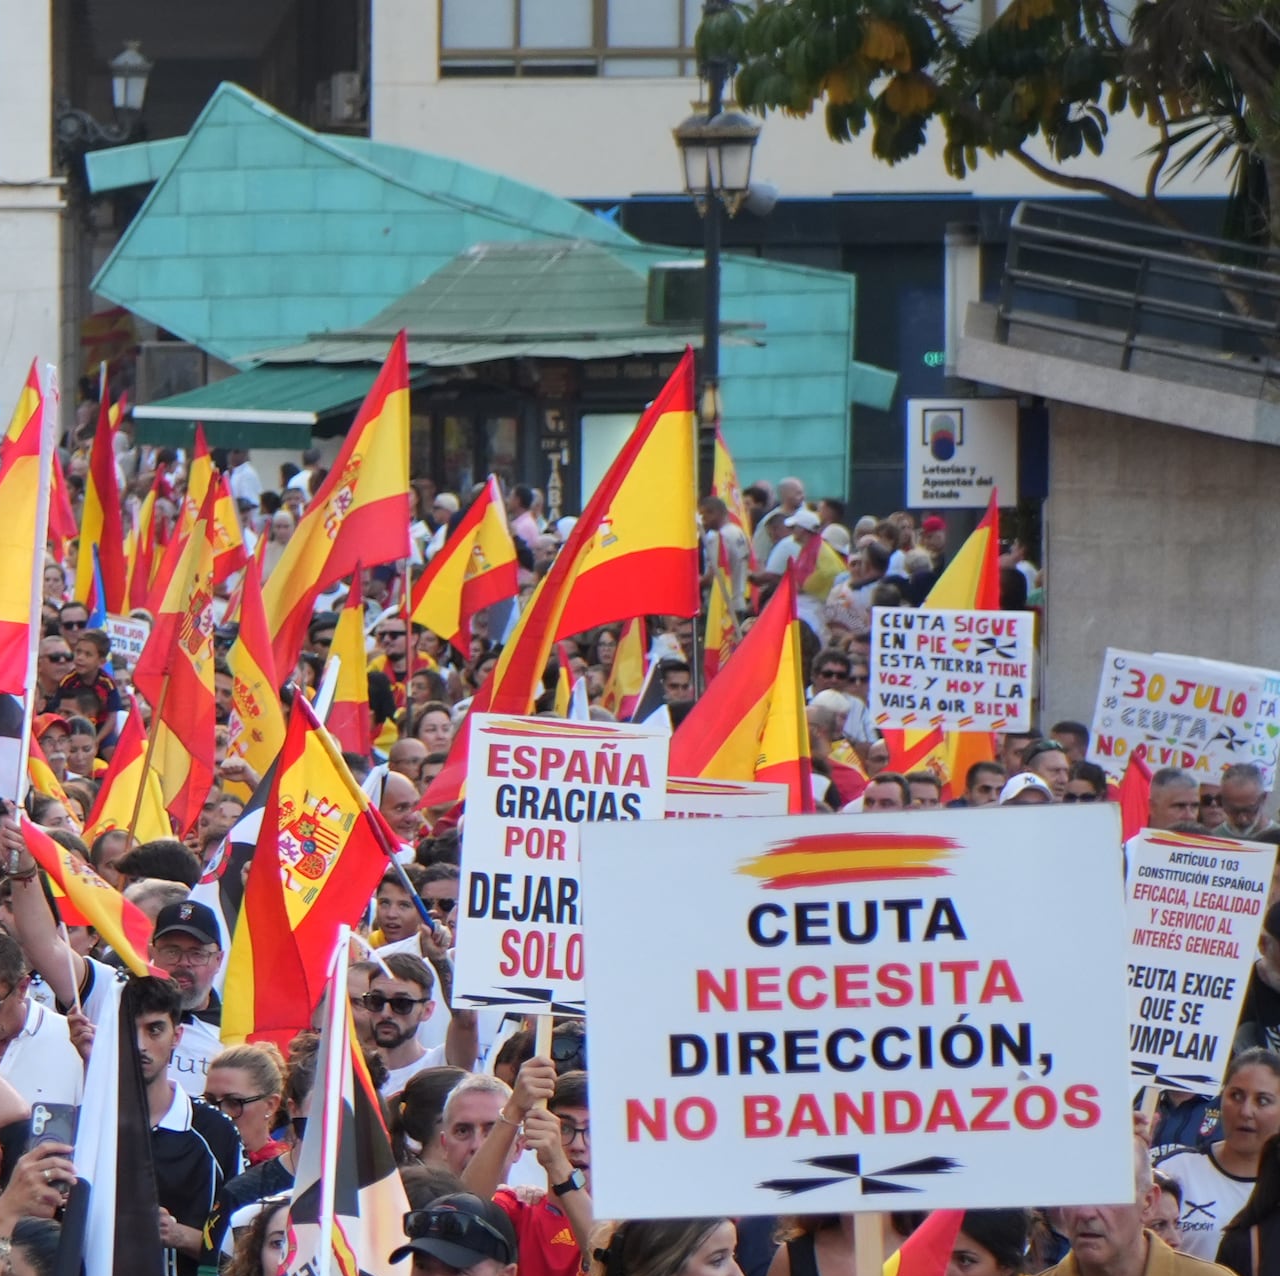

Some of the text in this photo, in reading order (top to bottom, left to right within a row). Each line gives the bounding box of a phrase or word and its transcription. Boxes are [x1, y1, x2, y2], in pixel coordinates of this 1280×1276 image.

[880, 613, 1017, 638] CEUTA SIGUE
[880, 633, 947, 654] EN PIE
[880, 654, 1027, 678] ESTA TIERRA TIENE
[879, 672, 1023, 698] VOZ, Y HOY LA
[1123, 668, 1166, 703] 30
[1169, 680, 1247, 718] JULIO
[880, 693, 1018, 717] VAIS A OIR BIEN
[1121, 707, 1207, 740] CEUTA
[487, 742, 651, 788] ESPAÑA
[1096, 734, 1210, 772] NO OLVIDA
[496, 784, 641, 822] GRACIAS
[504, 826, 567, 861] POR
[1169, 851, 1240, 871] ARTÍCULO 103
[1138, 865, 1264, 893] CONSTITUCIÓN ESPAÑOLA
[467, 871, 583, 925] DEJAR
[1133, 883, 1261, 916] EFICACIA, LEGALIDAD
[747, 897, 967, 947] CEUTA
[1150, 908, 1232, 935] Y SERVICIO AL
[1132, 928, 1239, 959] INTERÉS GENERAL
[696, 959, 1024, 1013] NECESITA
[1181, 972, 1236, 1000] EXIGE
[1139, 996, 1204, 1025] QUE SE
[668, 1013, 1053, 1077] DIRECCIÓN,
[1130, 1024, 1218, 1062] UMPLAN
[625, 1083, 1102, 1142] NO BANDAZOS
